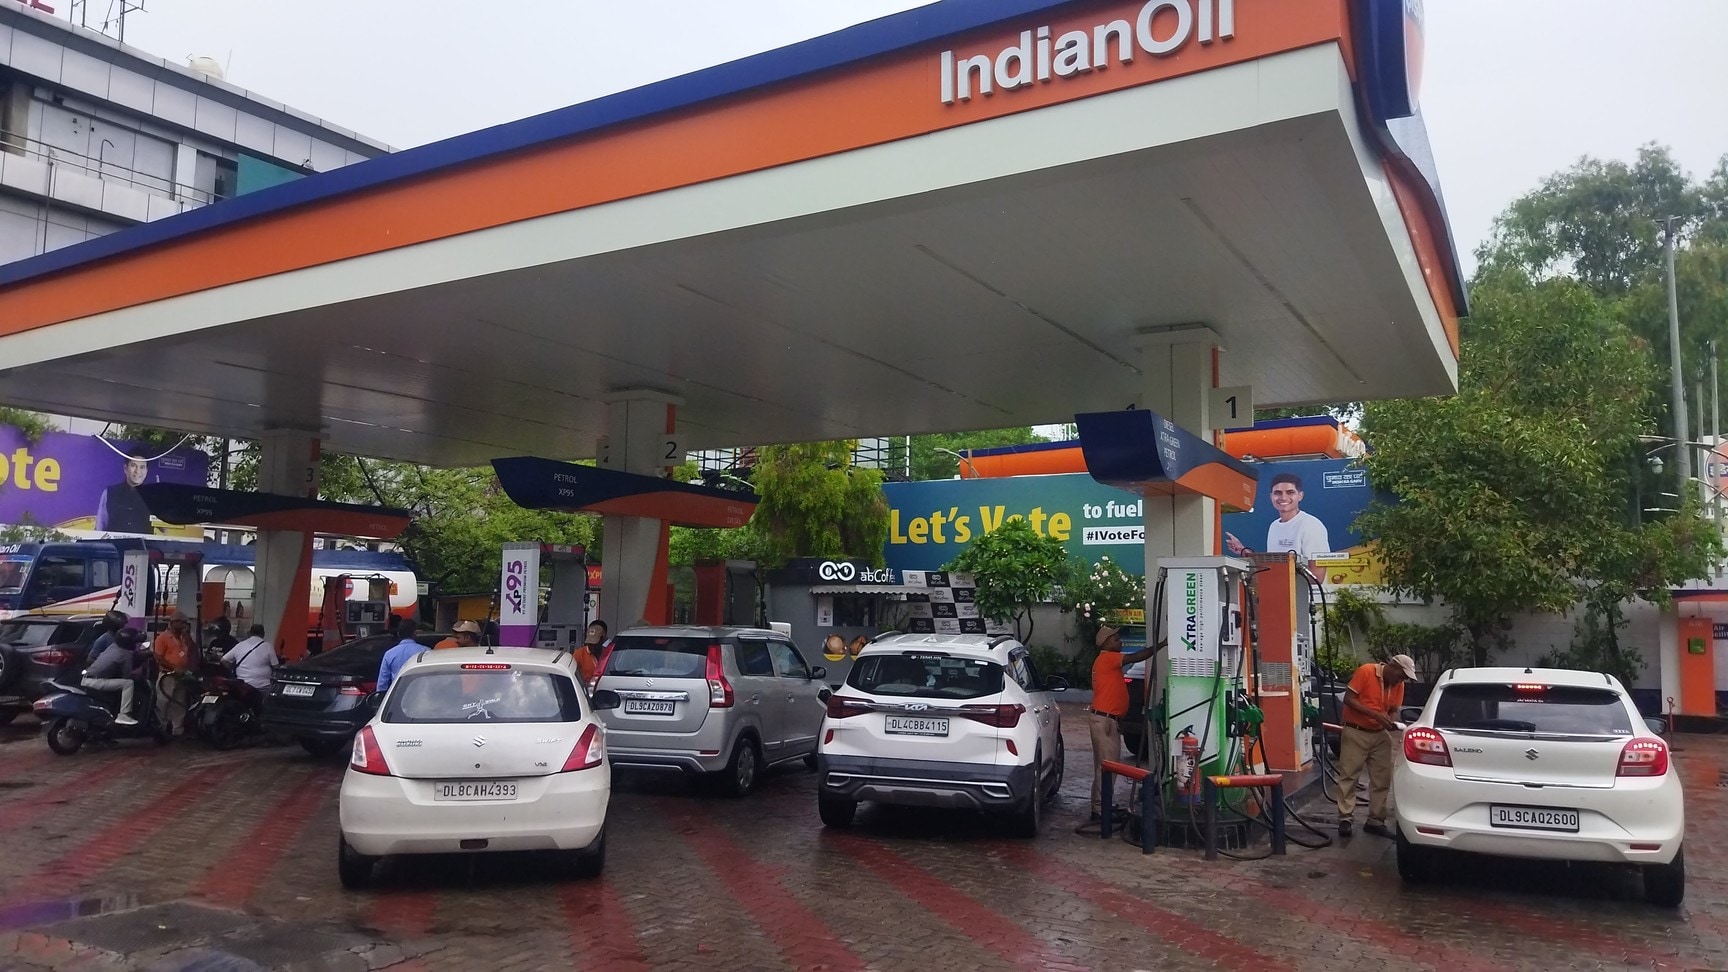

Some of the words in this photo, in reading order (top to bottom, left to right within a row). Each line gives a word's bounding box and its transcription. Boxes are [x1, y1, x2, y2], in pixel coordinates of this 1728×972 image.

[940, 0, 1234, 104] IndianOil
[1225, 396, 1237, 419] 1
[665, 441, 677, 459] 2
[1163, 447, 1177, 461] PETROL
[306, 468, 314, 482] 3
[553, 473, 577, 484] PETROL
[193, 494, 217, 504] PETROL
[558, 488, 575, 497] XP95
[1083, 503, 1103, 519] to
[1105, 499, 1143, 518] fuel
[1086, 529, 1145, 541] #IVoteFo
[124, 564, 135, 608] XP95
[505, 560, 523, 614] XP95
[1180, 572, 1196, 652] XTRAGREEN
[629, 701, 673, 712] DL9CAZ0878
[891, 719, 947, 732] DL4CBB4115
[442, 781, 517, 797] DL8CAH4393
[1499, 810, 1577, 826] DL9CAQ2600
